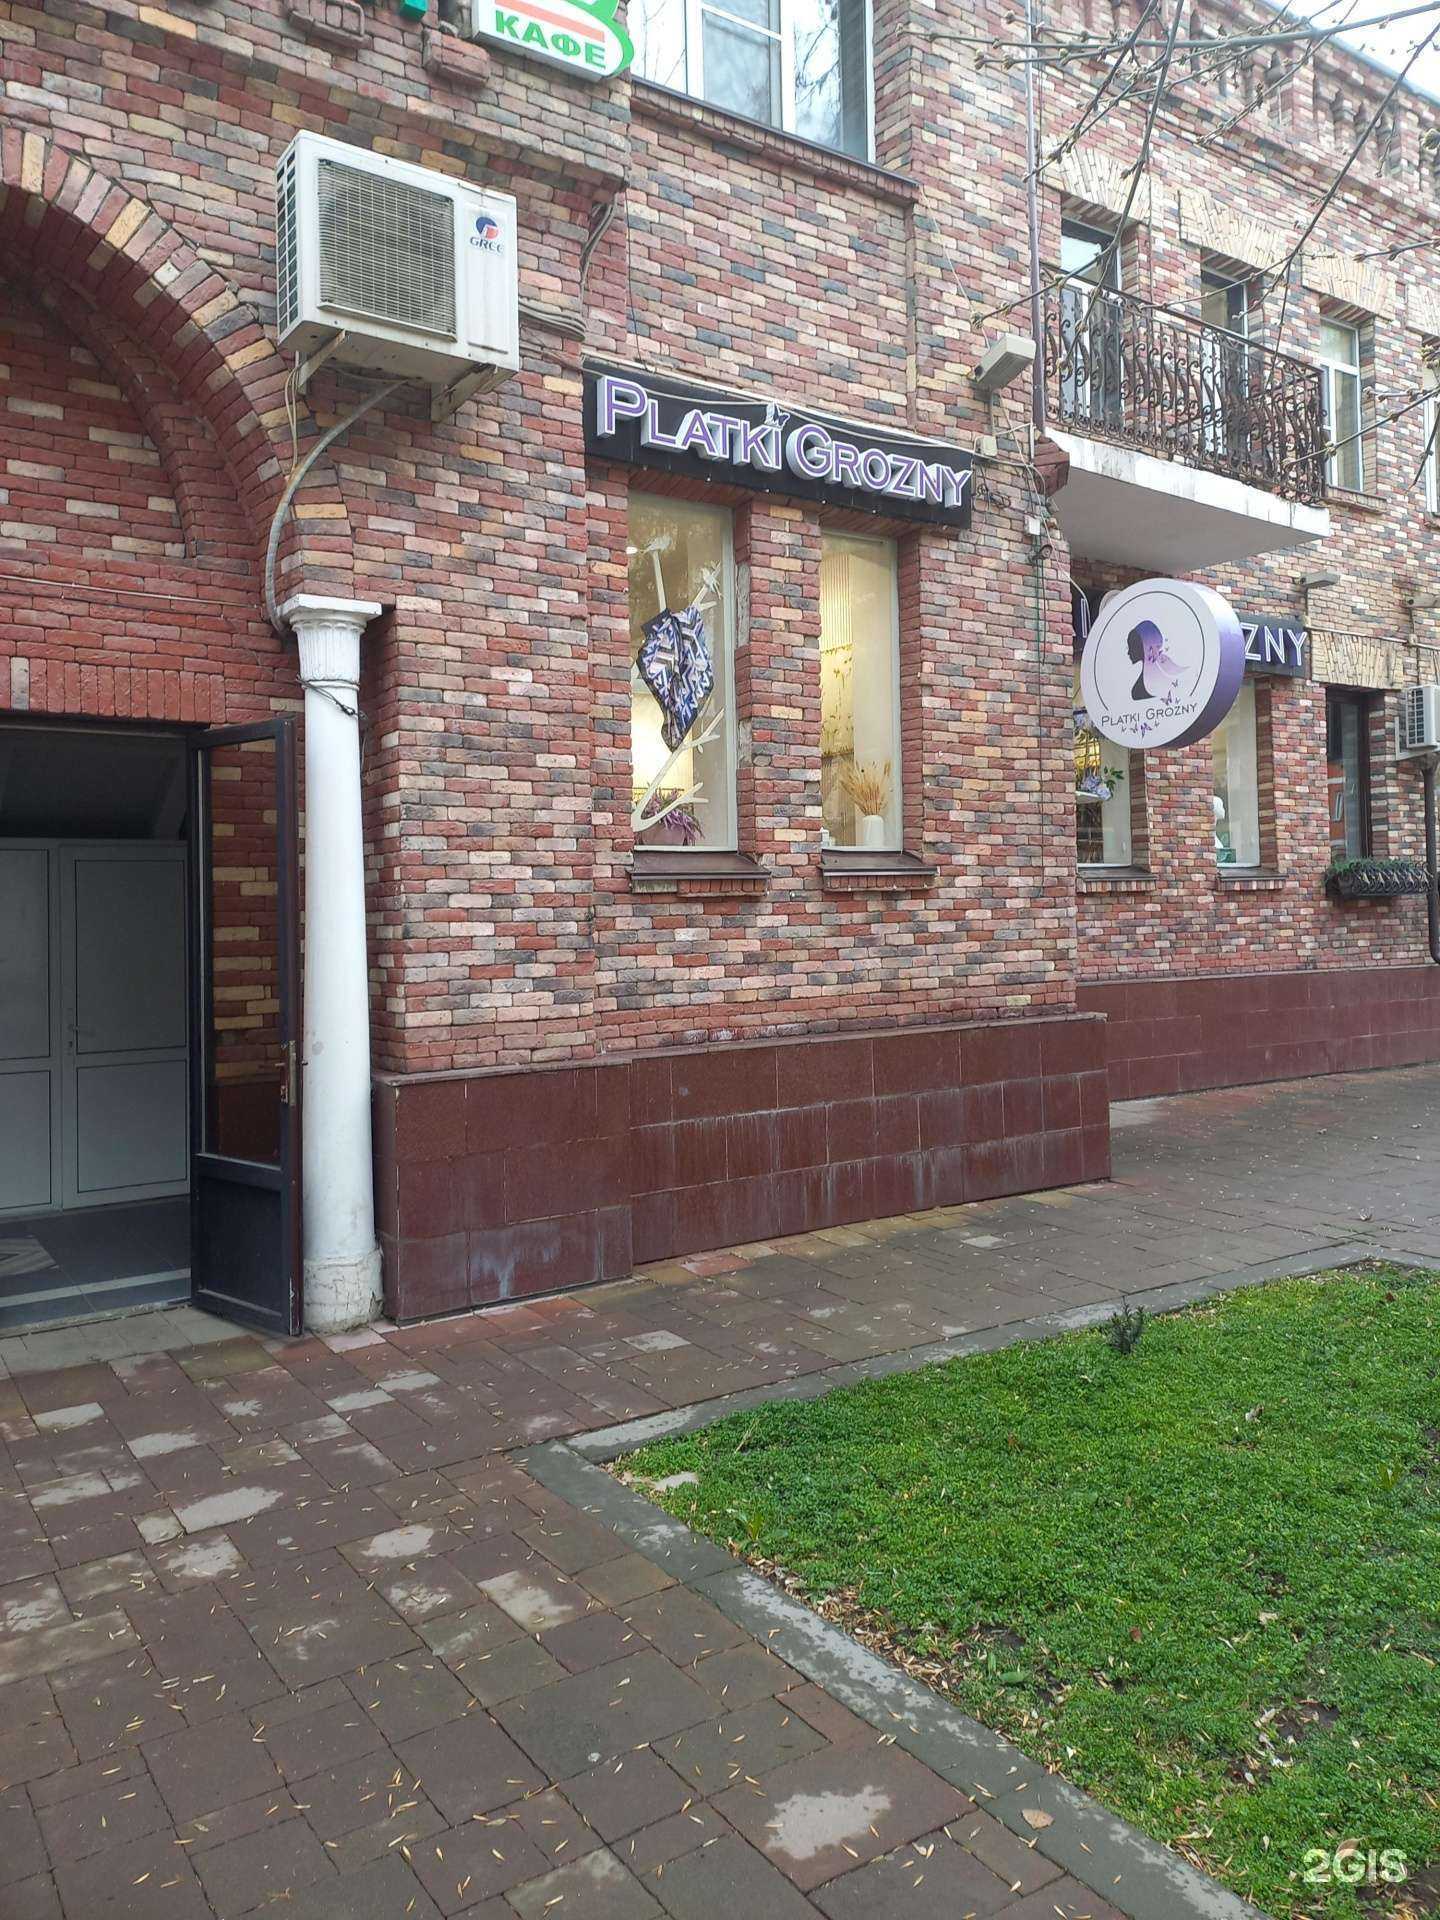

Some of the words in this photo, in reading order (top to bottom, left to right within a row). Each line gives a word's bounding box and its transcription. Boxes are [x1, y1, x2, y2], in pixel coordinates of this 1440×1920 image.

[495, 9, 606, 70] КАФЕ
[597, 376, 783, 471] PLATKI
[786, 423, 973, 508] GROZNY
[1242, 621, 1308, 667] ZNY
[1101, 712, 1140, 726] PLATKI
[1145, 702, 1198, 720] GROZNY
